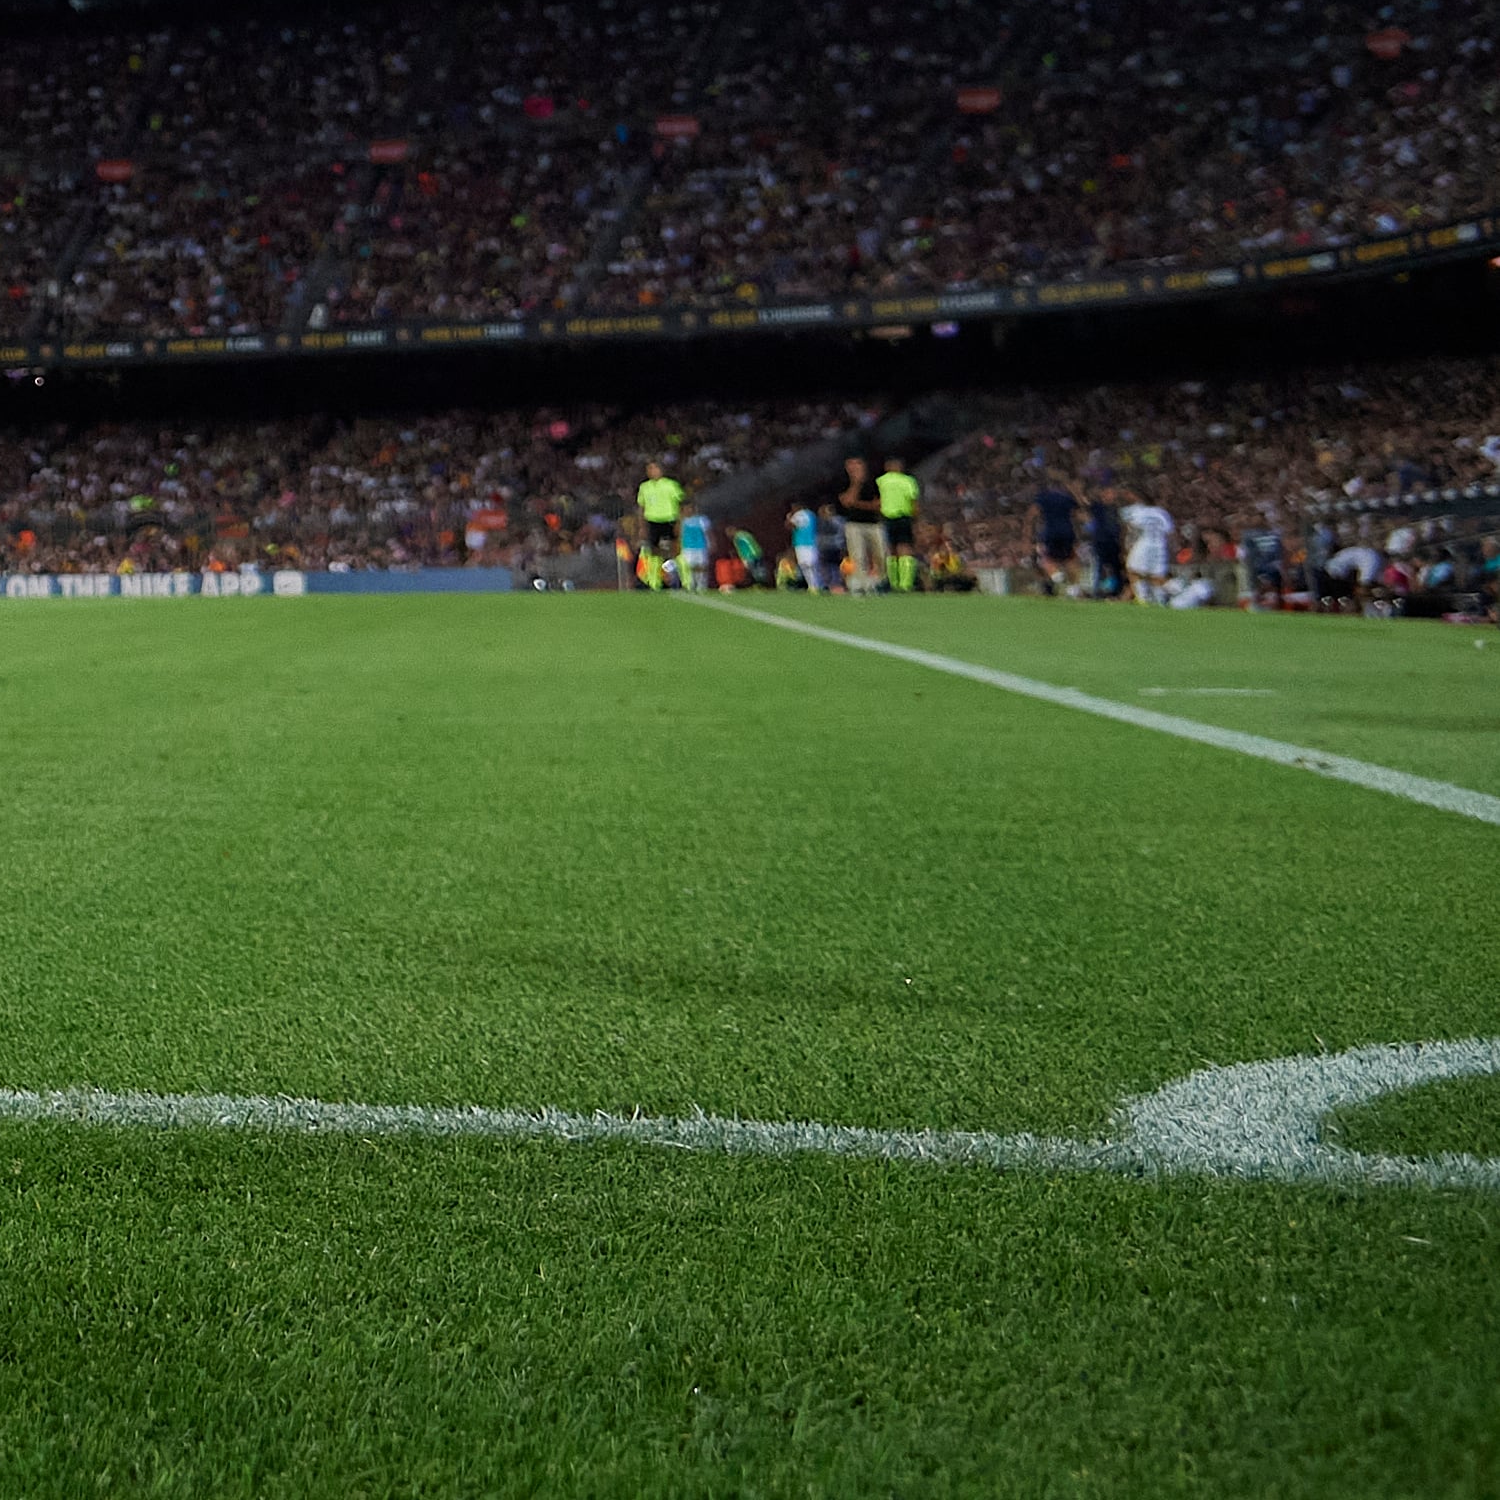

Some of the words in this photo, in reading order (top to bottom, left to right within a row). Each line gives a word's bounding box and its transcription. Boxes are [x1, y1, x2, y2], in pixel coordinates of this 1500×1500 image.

[5, 574, 50, 597] ON
[57, 574, 111, 597] THE
[119, 572, 192, 596] NIKE
